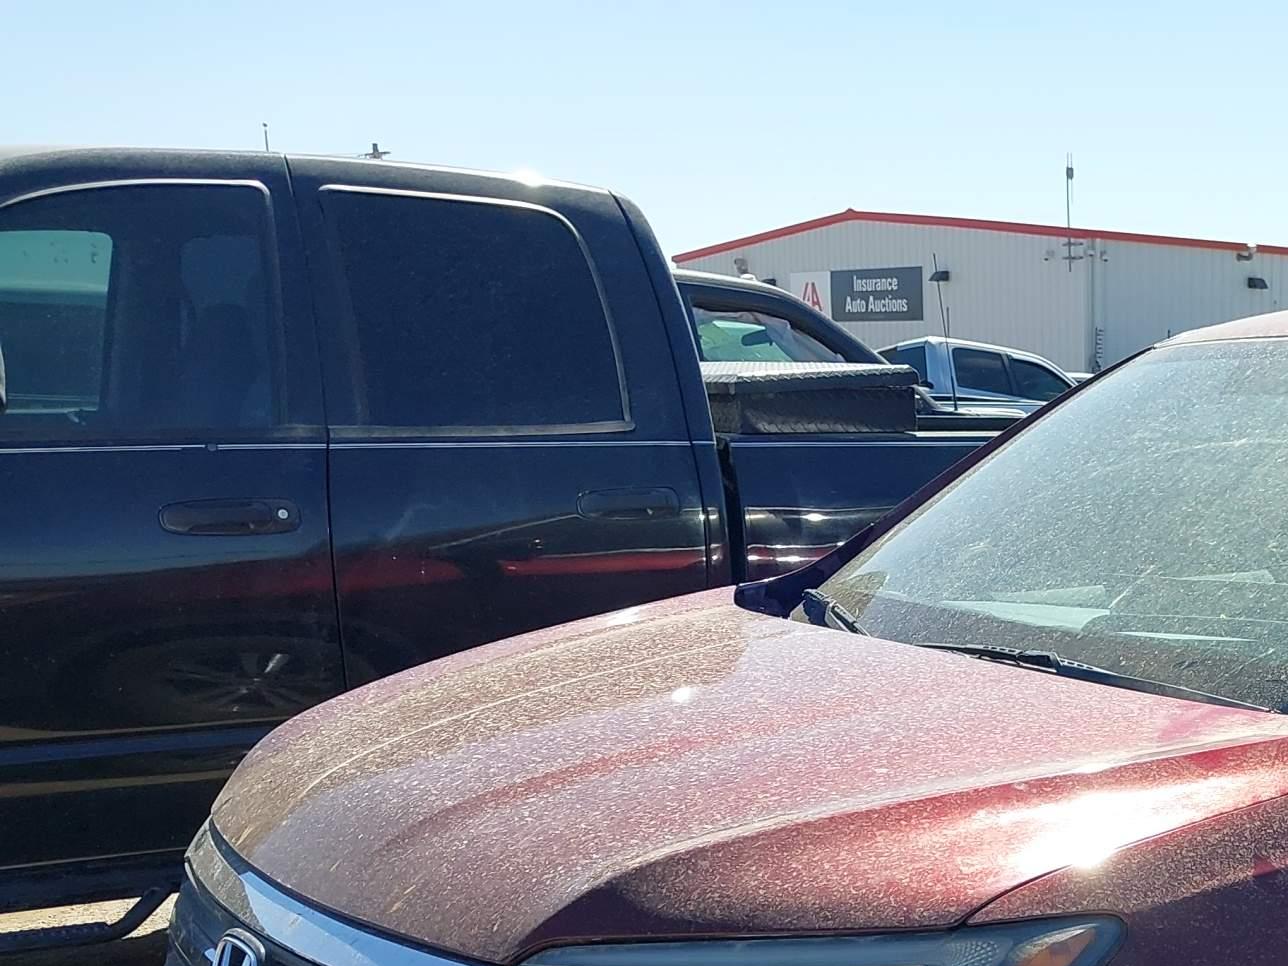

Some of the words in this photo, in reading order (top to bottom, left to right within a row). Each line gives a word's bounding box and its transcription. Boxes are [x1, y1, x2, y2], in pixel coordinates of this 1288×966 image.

[852, 274, 899, 292] Insurance
[845, 295, 867, 313] Auto
[867, 294, 909, 313] Auctions
